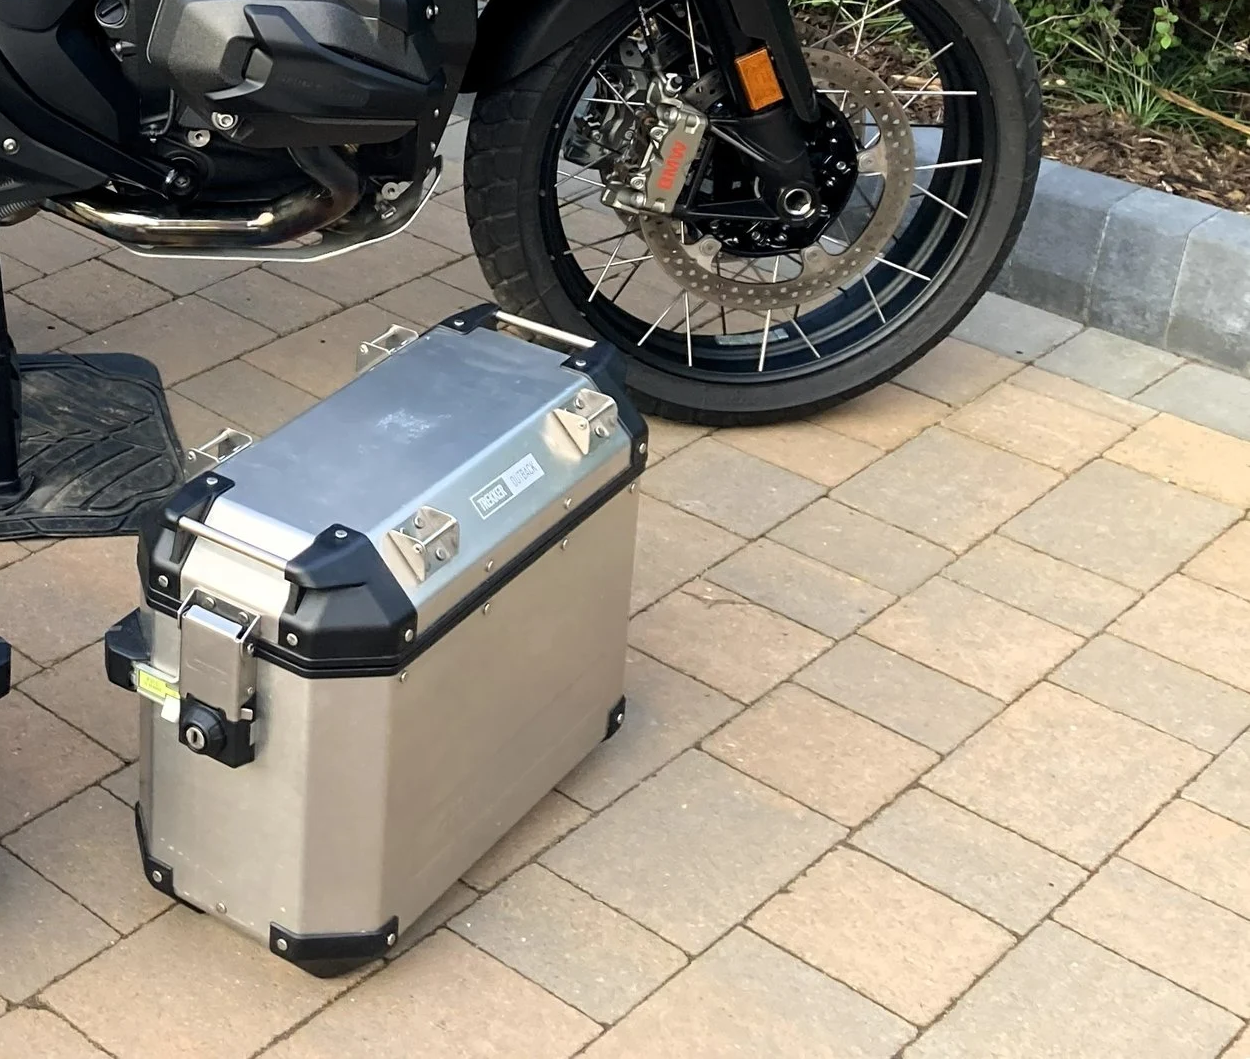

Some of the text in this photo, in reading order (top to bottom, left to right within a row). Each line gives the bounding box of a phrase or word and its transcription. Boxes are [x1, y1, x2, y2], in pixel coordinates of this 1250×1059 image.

[658, 140, 687, 190] BMW
[477, 460, 539, 512] TREKKER OUTBACK
